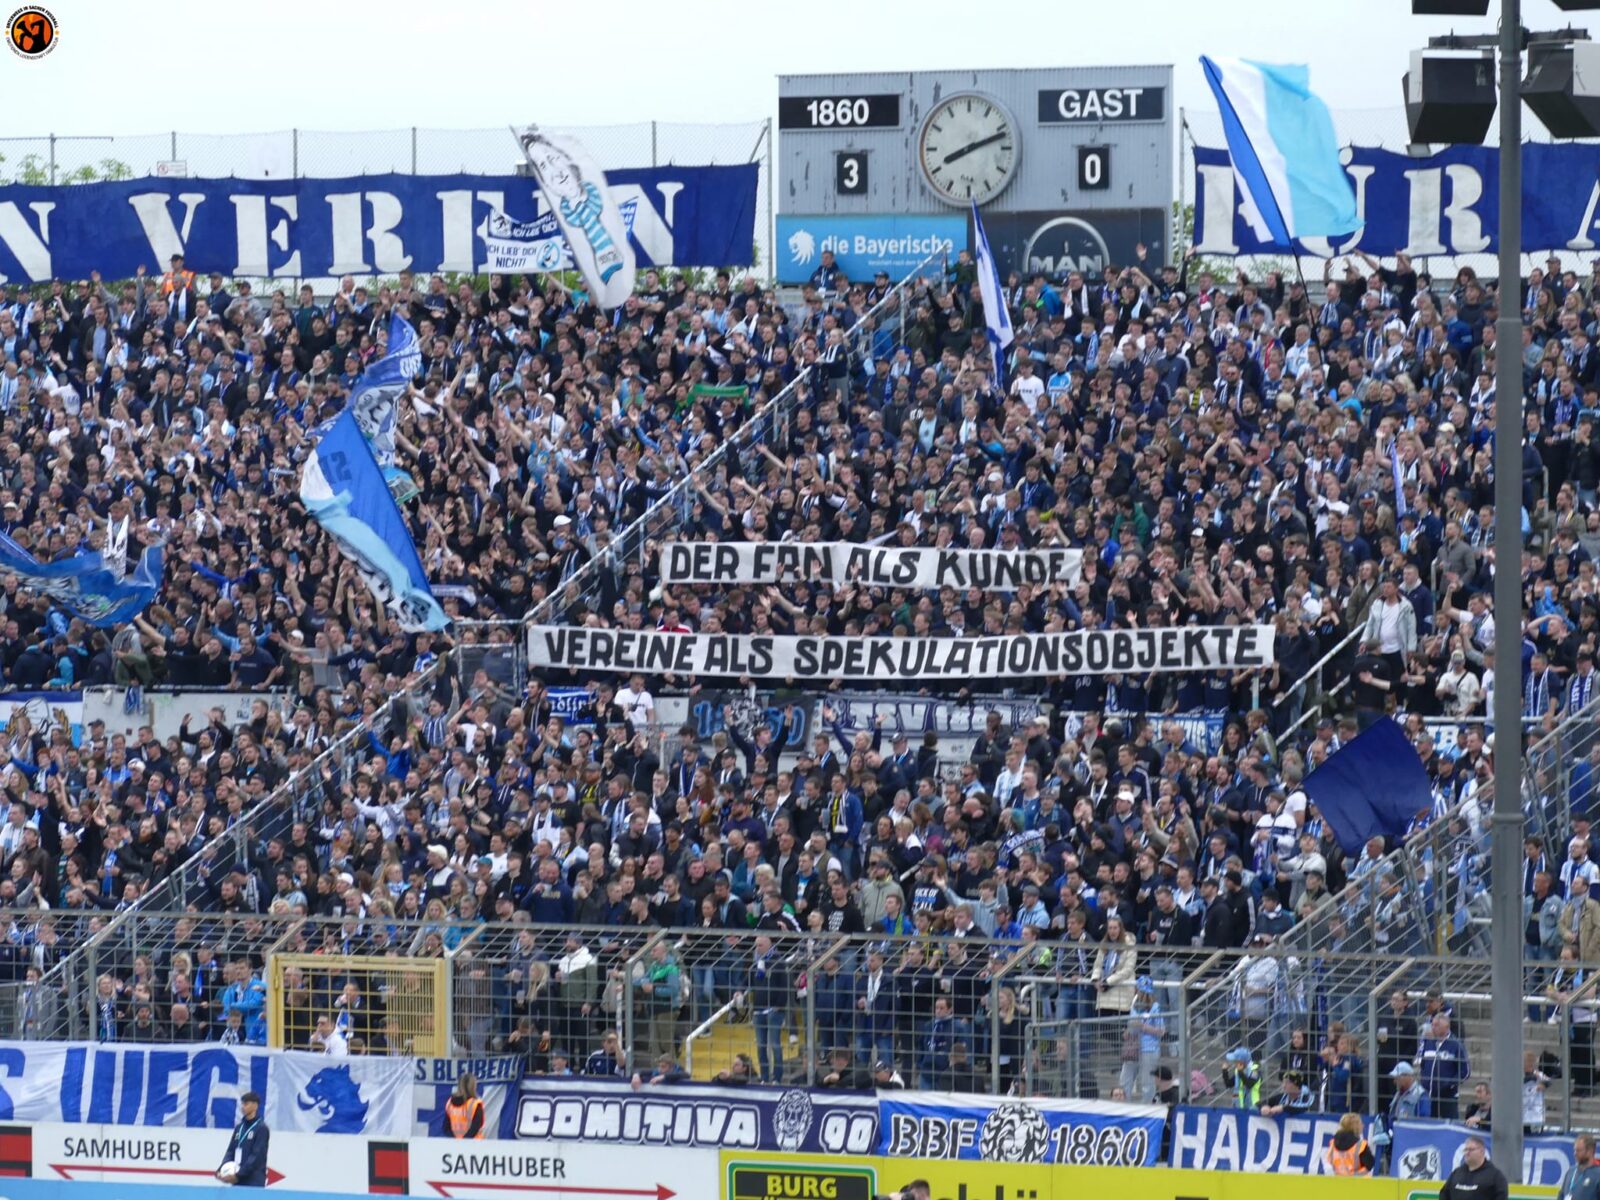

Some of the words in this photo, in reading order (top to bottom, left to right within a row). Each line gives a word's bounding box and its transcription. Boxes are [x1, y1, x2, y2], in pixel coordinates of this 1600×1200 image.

[806, 98, 870, 126] 1860
[1058, 89, 1143, 118] GAST
[843, 159, 859, 189] 3
[1084, 154, 1101, 185] 0
[821, 235, 849, 254] die
[854, 234, 953, 258] Bayerische
[1030, 255, 1102, 272] MAN
[670, 545, 740, 580] DER
[754, 546, 832, 580] FAN
[846, 547, 921, 585] ALS
[936, 552, 1069, 588] KUNDE
[545, 629, 697, 671] VEREINE
[703, 637, 772, 676] ALS
[794, 629, 1264, 677] SPEKULATIONSOBJEKTE
[433, 1056, 518, 1082] BLEIBEN!
[518, 1097, 759, 1149] COMITIVA
[822, 1110, 876, 1154] 90
[63, 1136, 182, 1162] SAMHUBER
[888, 1114, 978, 1159] BBF
[1052, 1123, 1149, 1168] 1860
[441, 1153, 566, 1179] SAMHUBER
[767, 1174, 837, 1198] BURG
